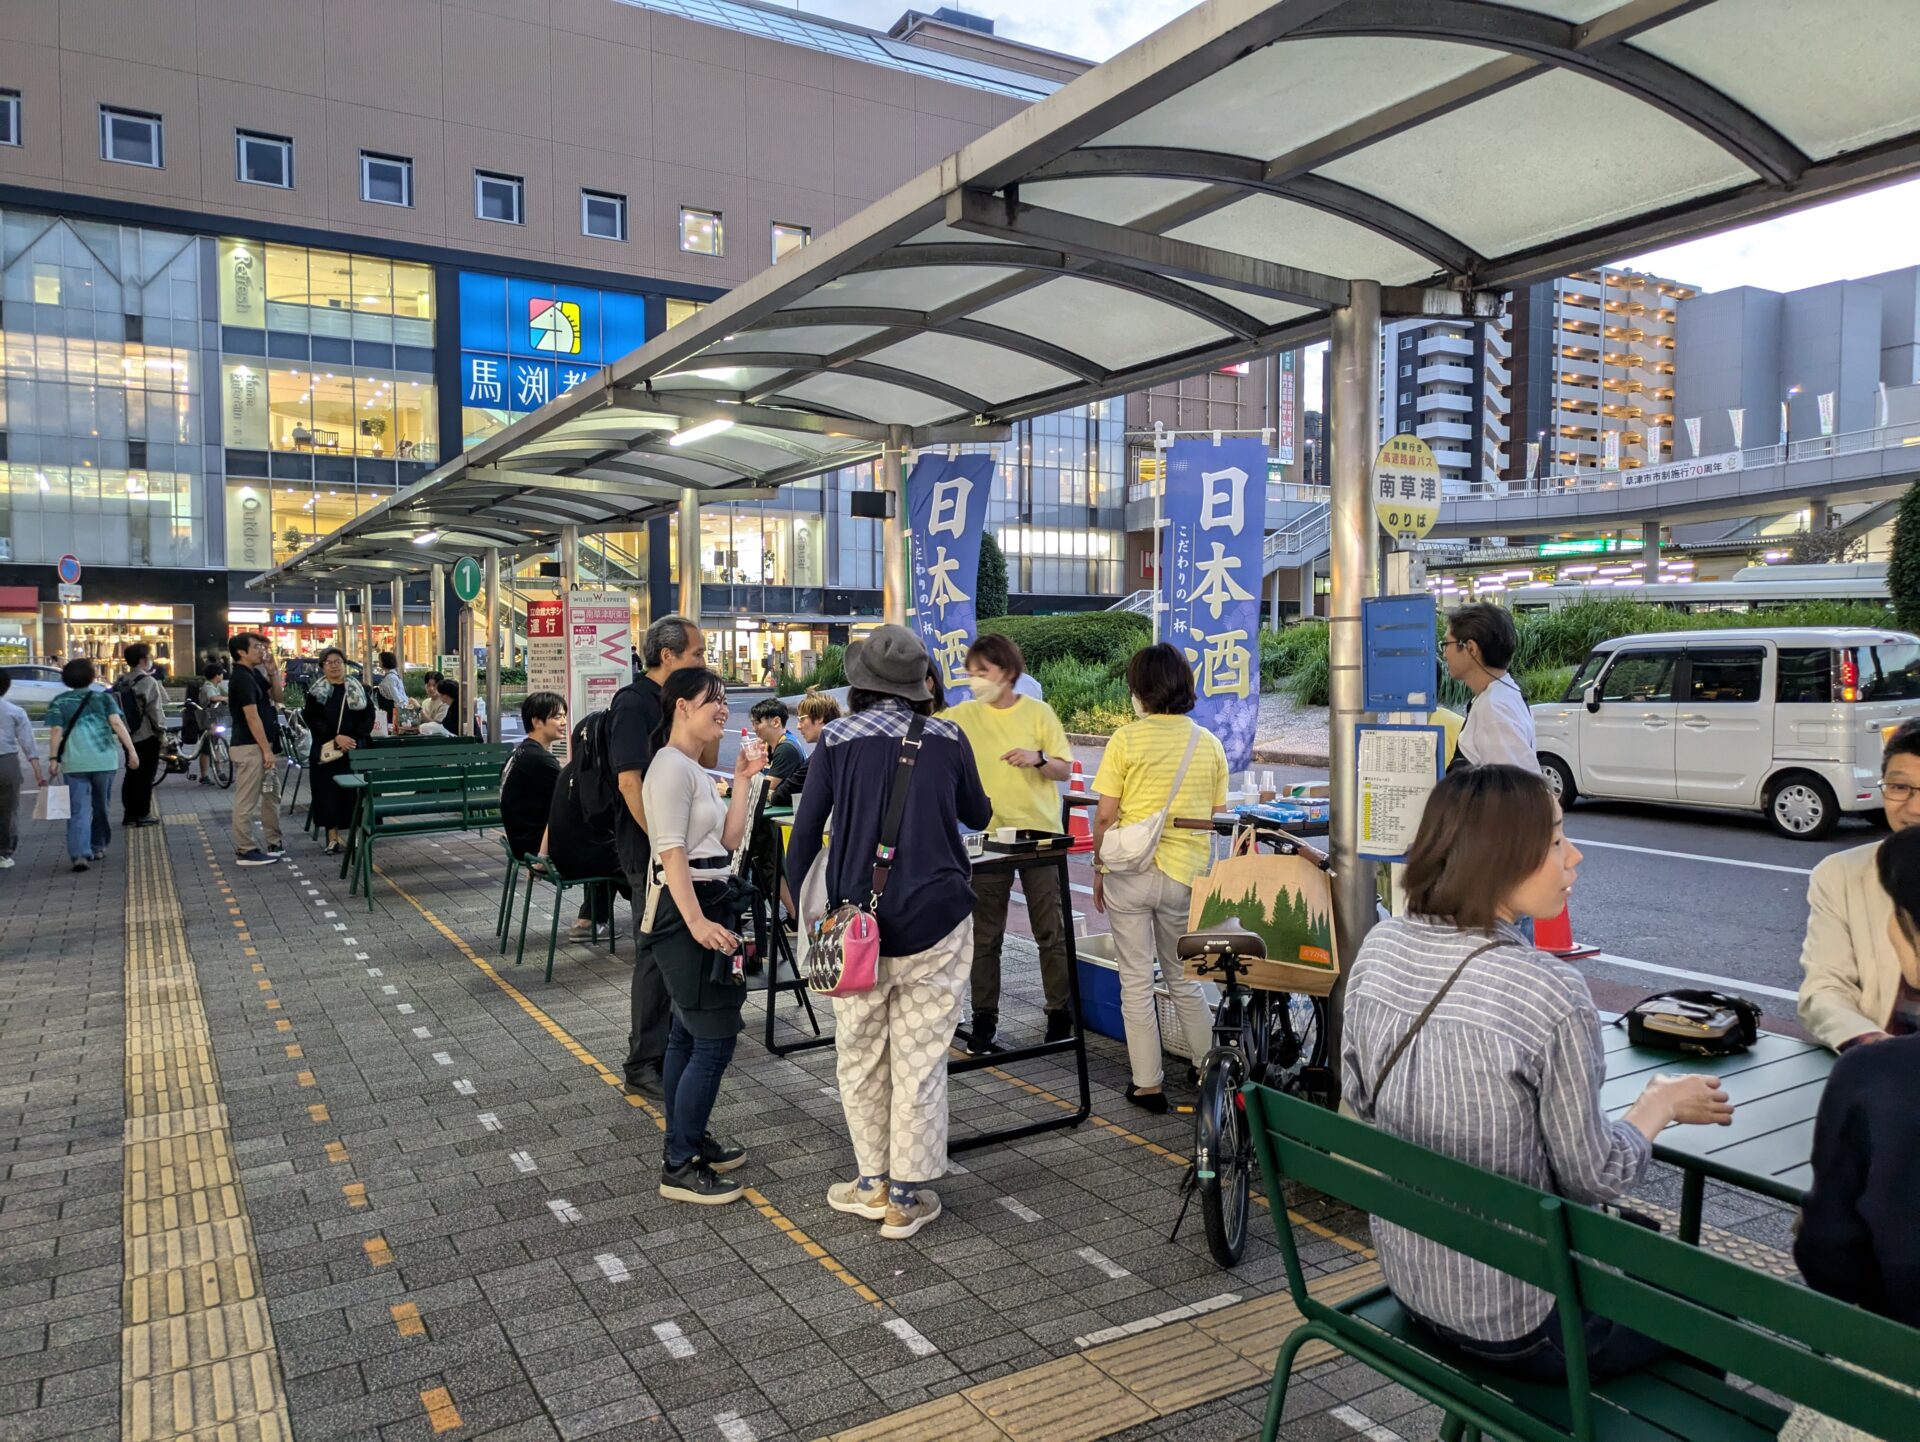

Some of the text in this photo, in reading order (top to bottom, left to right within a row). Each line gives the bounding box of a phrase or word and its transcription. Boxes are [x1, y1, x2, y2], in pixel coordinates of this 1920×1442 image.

[234, 255, 253, 313] Refresh
[1383, 452, 1433, 467] 高速路線バス
[1624, 462, 1722, 486] 草津市市制施行70周年
[1379, 472, 1437, 502] 南草津
[243, 498, 261, 564] Outdoor
[1388, 512, 1426, 529] のりば
[462, 565, 471, 593] 1
[928, 476, 975, 690] 日本酒
[1172, 526, 1189, 634] こだわりの一杯
[1183, 466, 1256, 699] 日本酒
